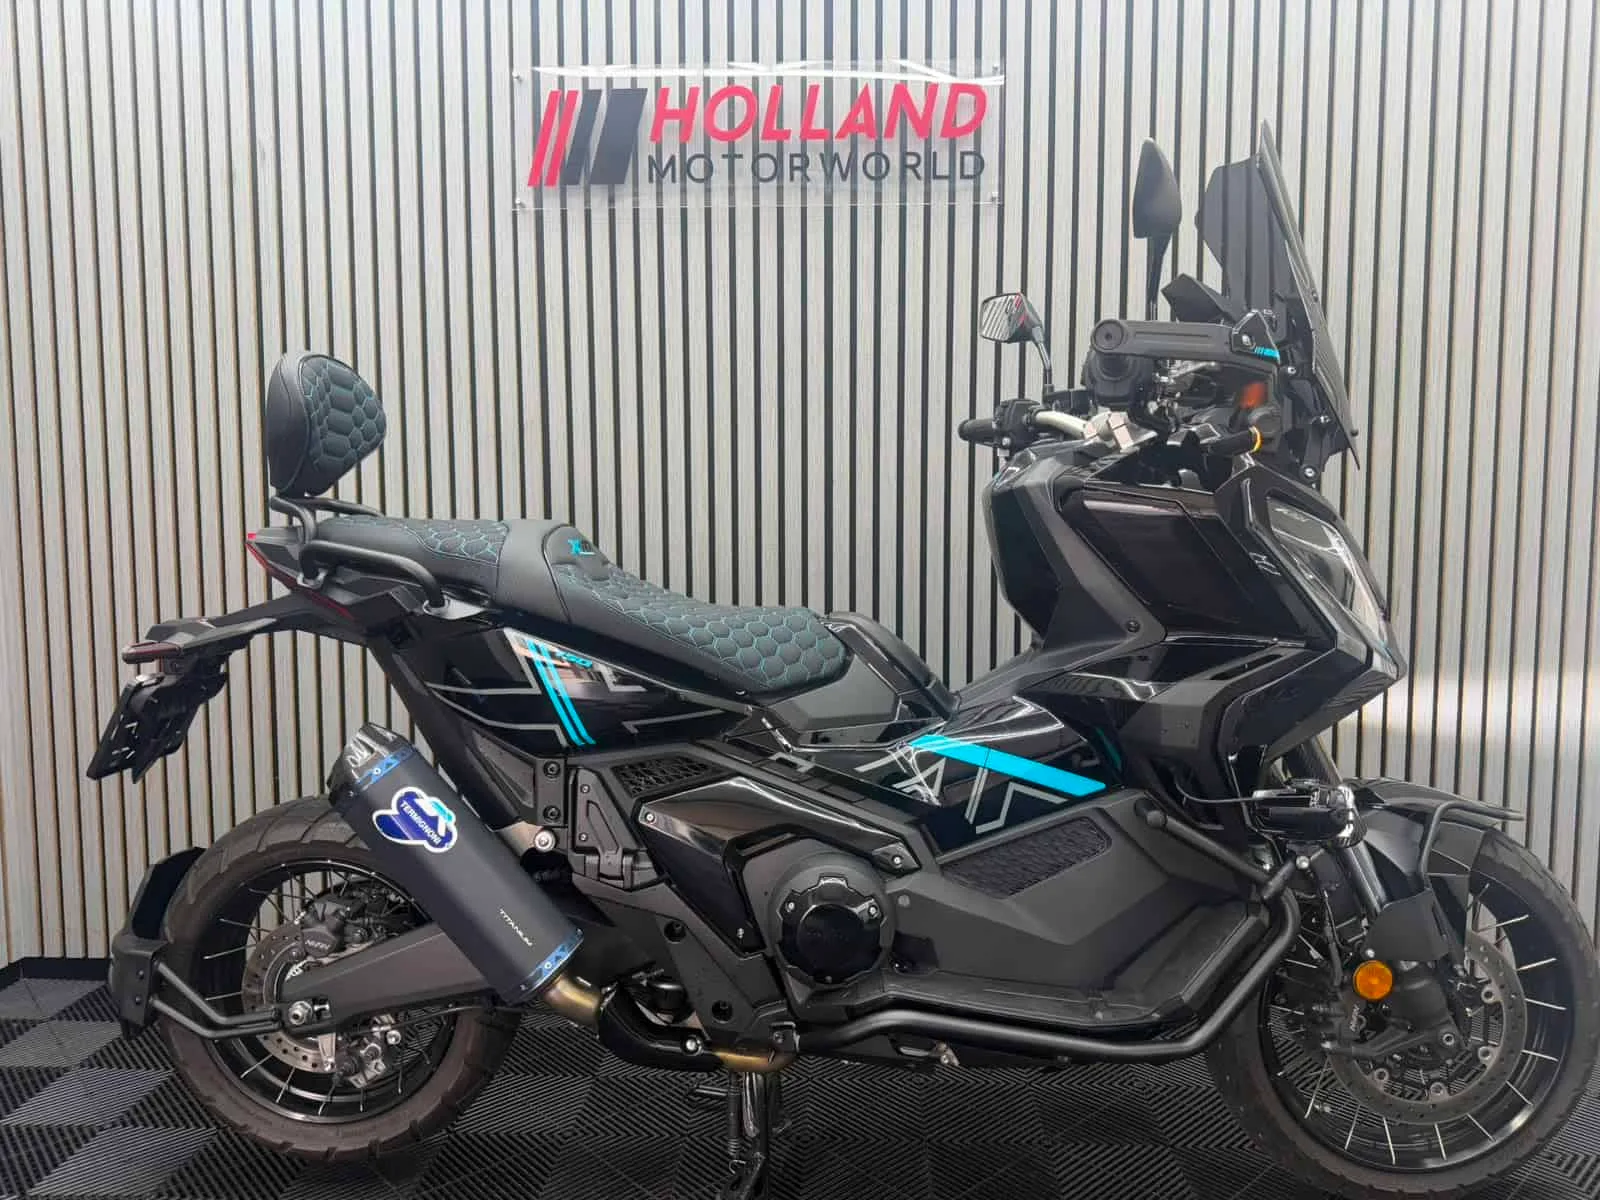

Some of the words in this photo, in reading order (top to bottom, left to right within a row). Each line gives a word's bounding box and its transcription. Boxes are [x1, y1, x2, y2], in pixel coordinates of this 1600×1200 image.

[649, 82, 988, 143] HOLLAND
[648, 151, 986, 184] MOTORWORLD
[400, 800, 442, 846] TERMIGNONI
